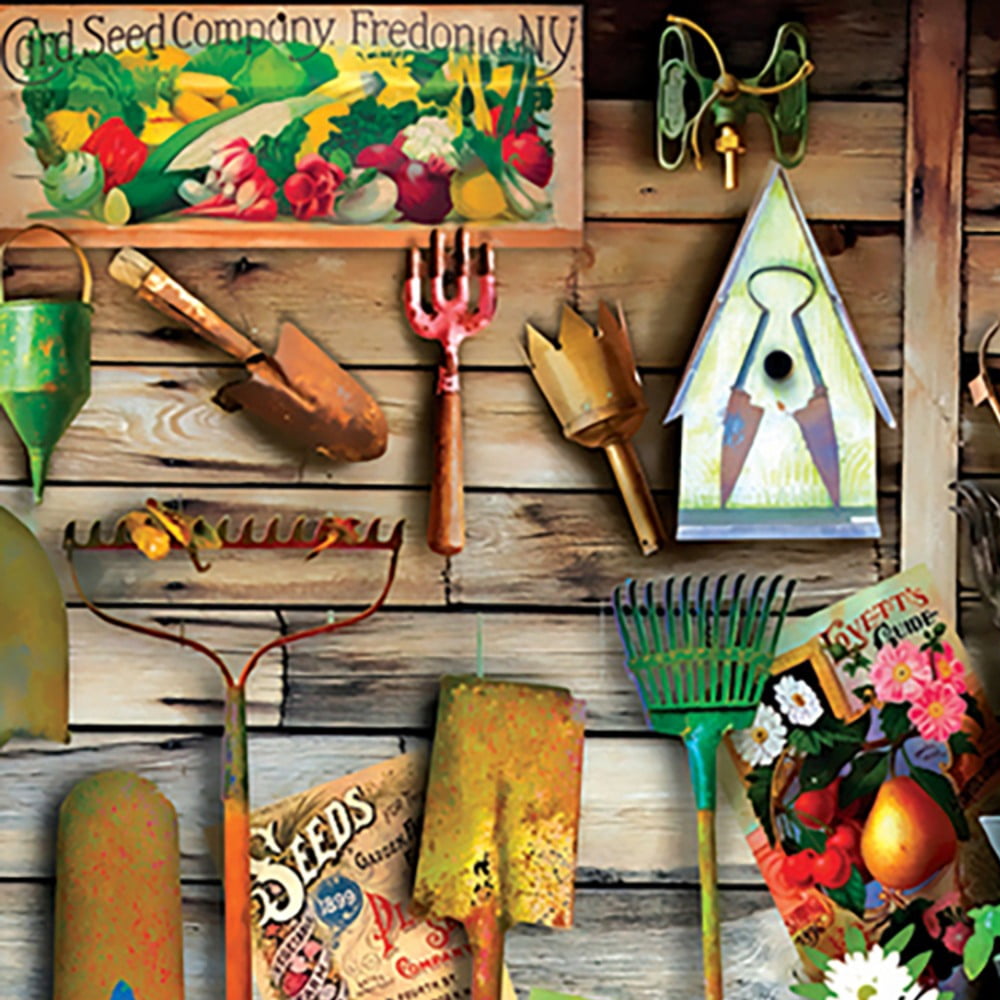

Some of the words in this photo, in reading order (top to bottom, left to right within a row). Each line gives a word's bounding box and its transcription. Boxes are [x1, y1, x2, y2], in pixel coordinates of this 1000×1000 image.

[1, 16, 74, 85] Card
[83, 14, 166, 59] Seed
[350, 9, 508, 55] Fredonia
[249, 785, 376, 929] SEEDS
